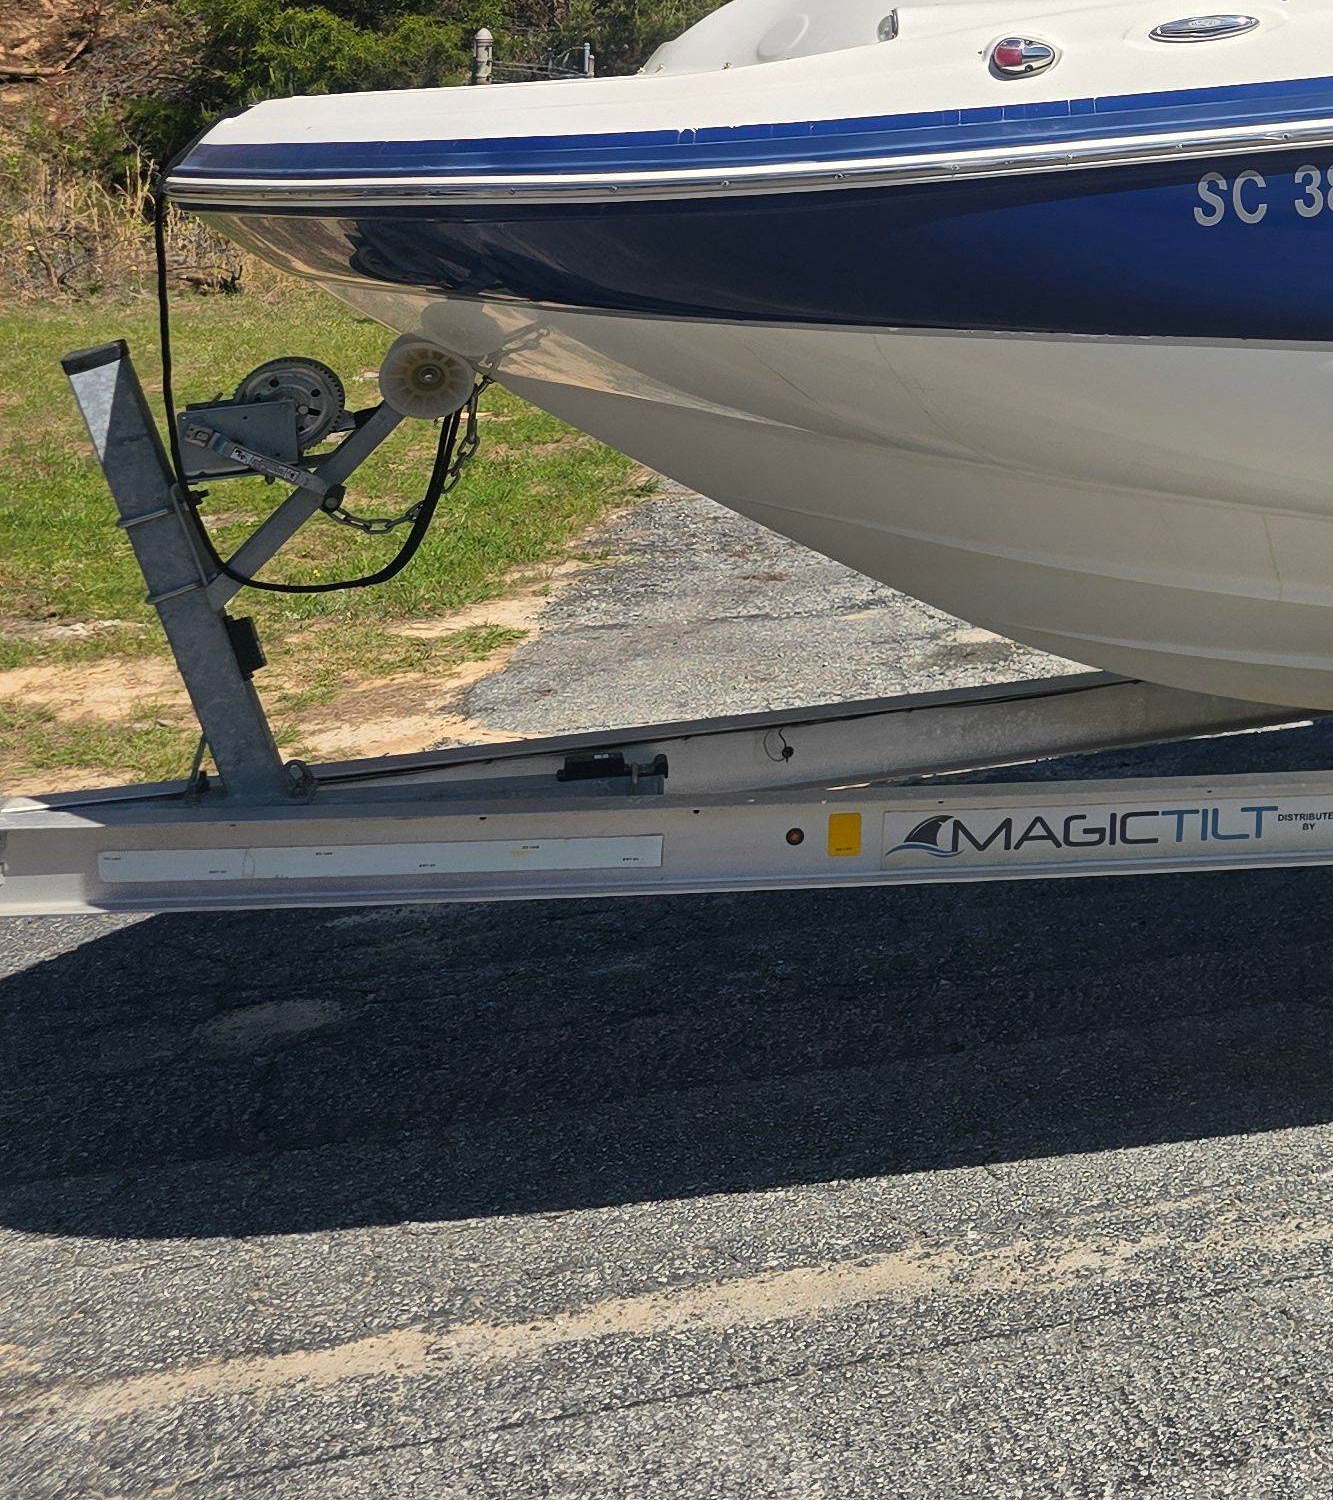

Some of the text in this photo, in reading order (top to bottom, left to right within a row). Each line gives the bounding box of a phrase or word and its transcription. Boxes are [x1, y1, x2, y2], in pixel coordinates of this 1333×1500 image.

[1193, 171, 1267, 226] SC
[950, 805, 1279, 852] MAGICTILT
[1302, 822, 1316, 831] BY
